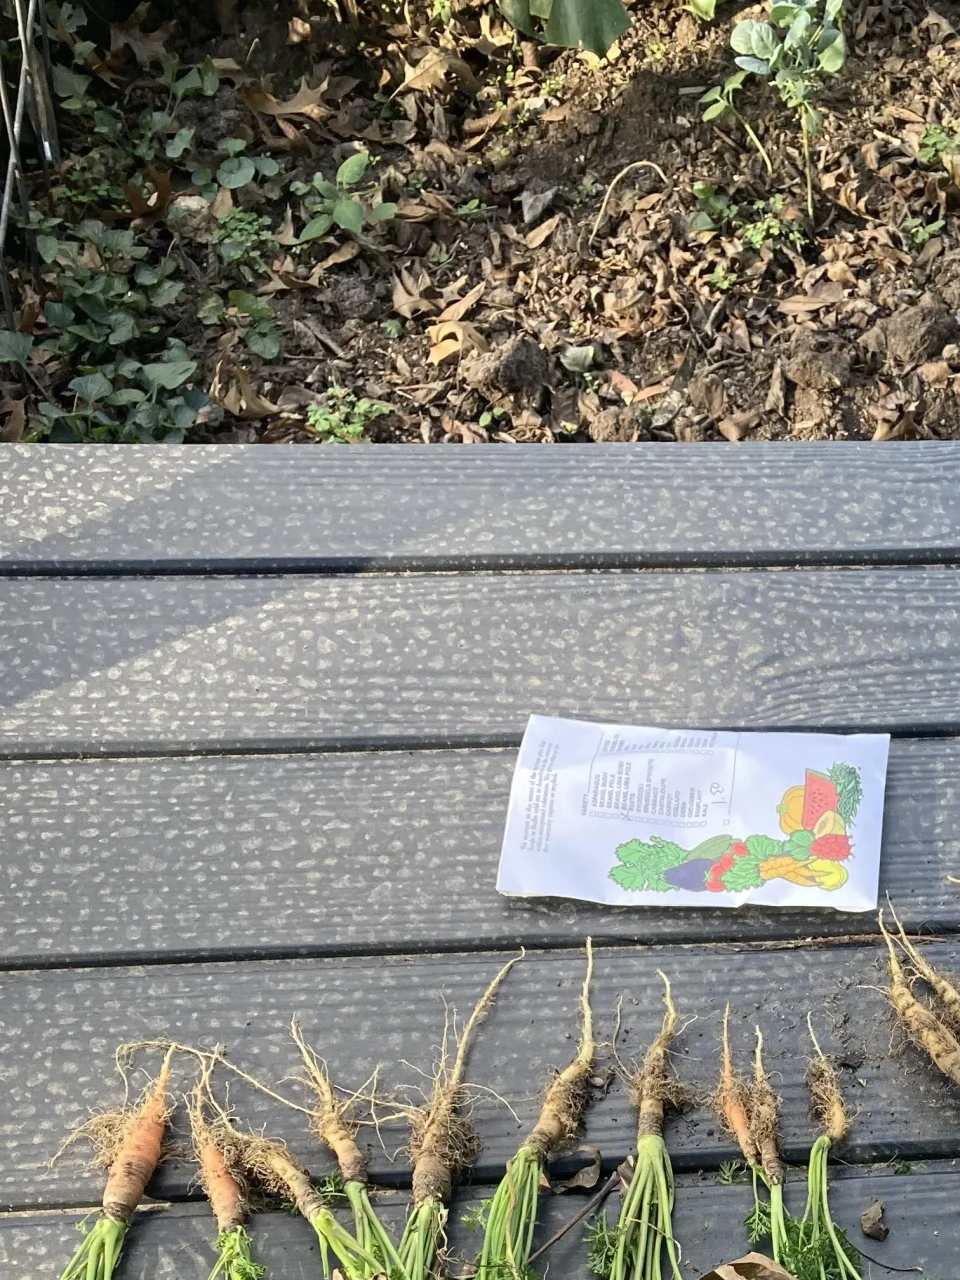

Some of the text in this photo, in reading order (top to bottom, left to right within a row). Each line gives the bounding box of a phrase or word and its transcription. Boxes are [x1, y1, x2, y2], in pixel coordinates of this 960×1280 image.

[646, 759, 654, 782] SPROUTS
[592, 775, 600, 807] ASPARAGUS
[658, 778, 666, 815] CANTALOUPE
